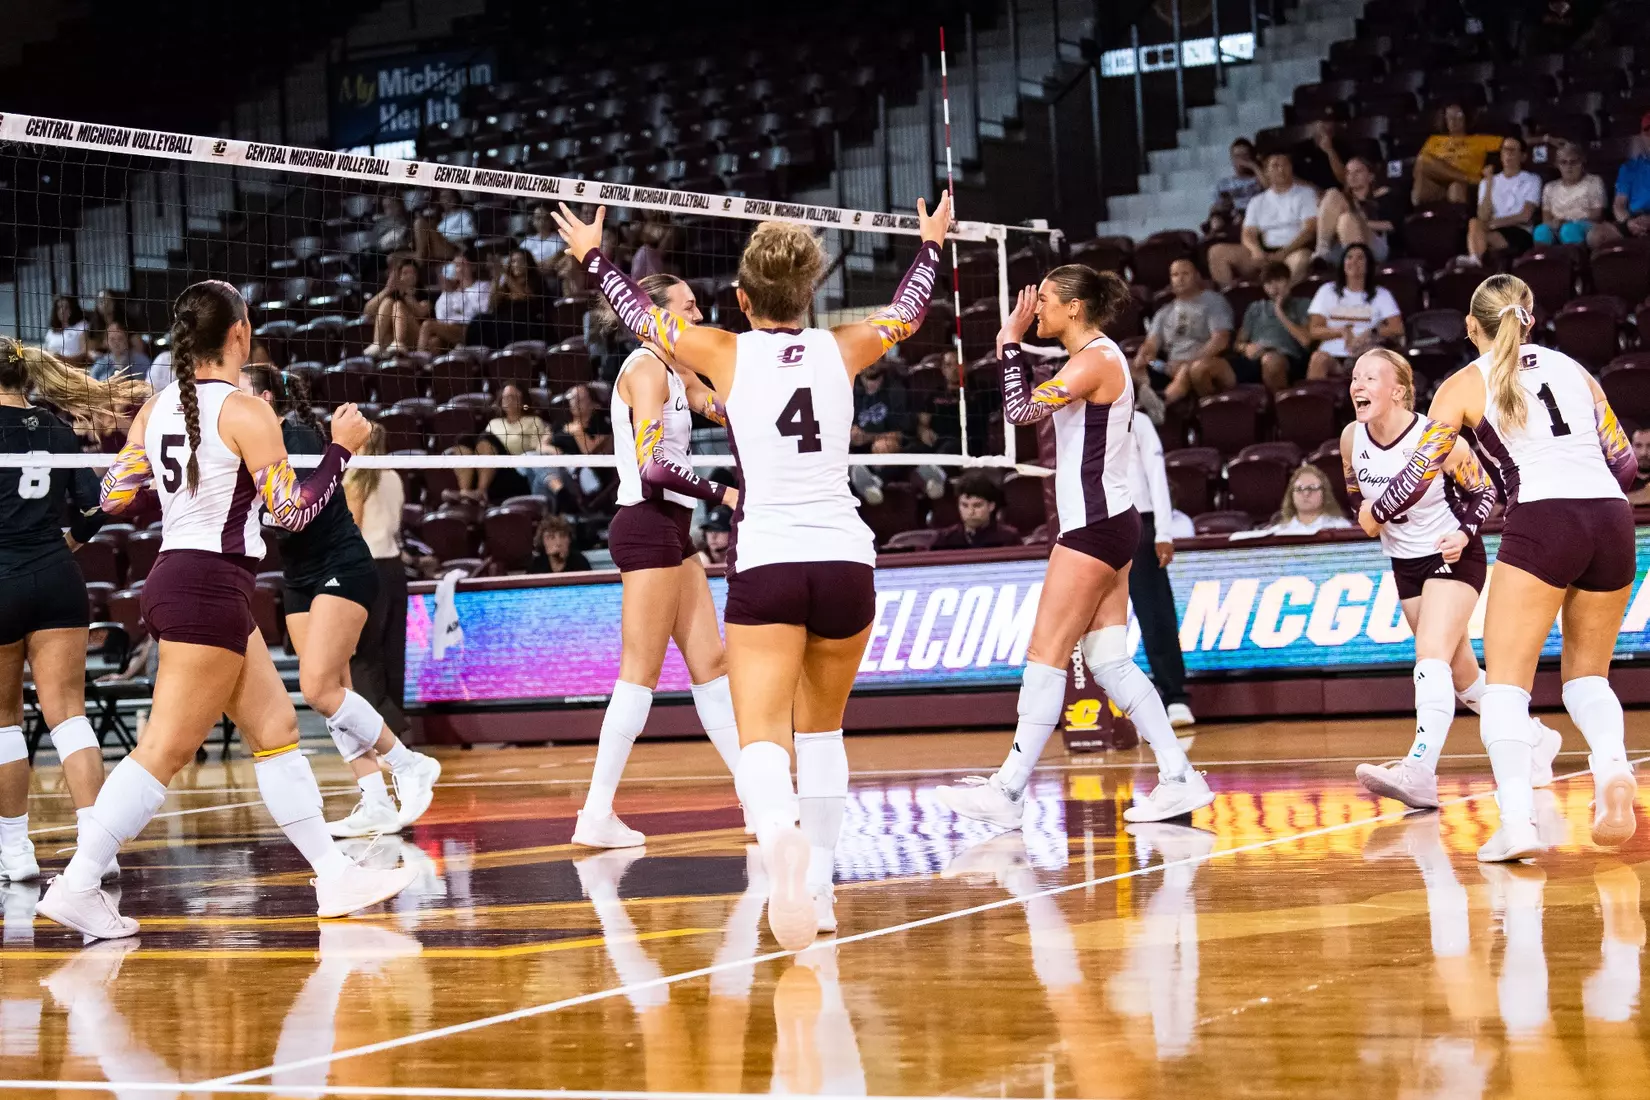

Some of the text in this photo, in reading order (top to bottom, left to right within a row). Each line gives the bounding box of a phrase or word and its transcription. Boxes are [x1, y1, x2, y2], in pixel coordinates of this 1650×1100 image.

[25, 117, 74, 141] CENTRAL
[76, 124, 132, 148] MICHIGAN
[131, 130, 193, 155] VOLLEYBALL
[245, 143, 286, 164] CENTRAL
[288, 149, 336, 170] MICHIGAN
[337, 154, 390, 176] VOLLEYBALL
[434, 166, 471, 185] CENTRAL
[472, 171, 514, 190] MICHIGAN
[513, 175, 561, 194] VOLLEYBALL
[599, 184, 631, 201] CENTRAL
[632, 188, 669, 205] MICHIGAN
[668, 191, 710, 210] VOLLEYBALL
[743, 200, 772, 216] CENTRAL
[772, 203, 805, 219] MICHIGAN
[804, 207, 842, 223] VOLLEYBALL
[872, 213, 897, 228] CENTRAL
[898, 216, 920, 230] MICHI
[600, 270, 655, 338] CHIPPEWAS
[775, 387, 822, 454] 4
[1537, 382, 1572, 437] 1
[17, 450, 52, 500] 8
[160, 434, 186, 494] 5
[1358, 467, 1392, 488] Chipp
[858, 583, 1045, 672] ELCOM
[1179, 570, 1416, 652] MCGU
